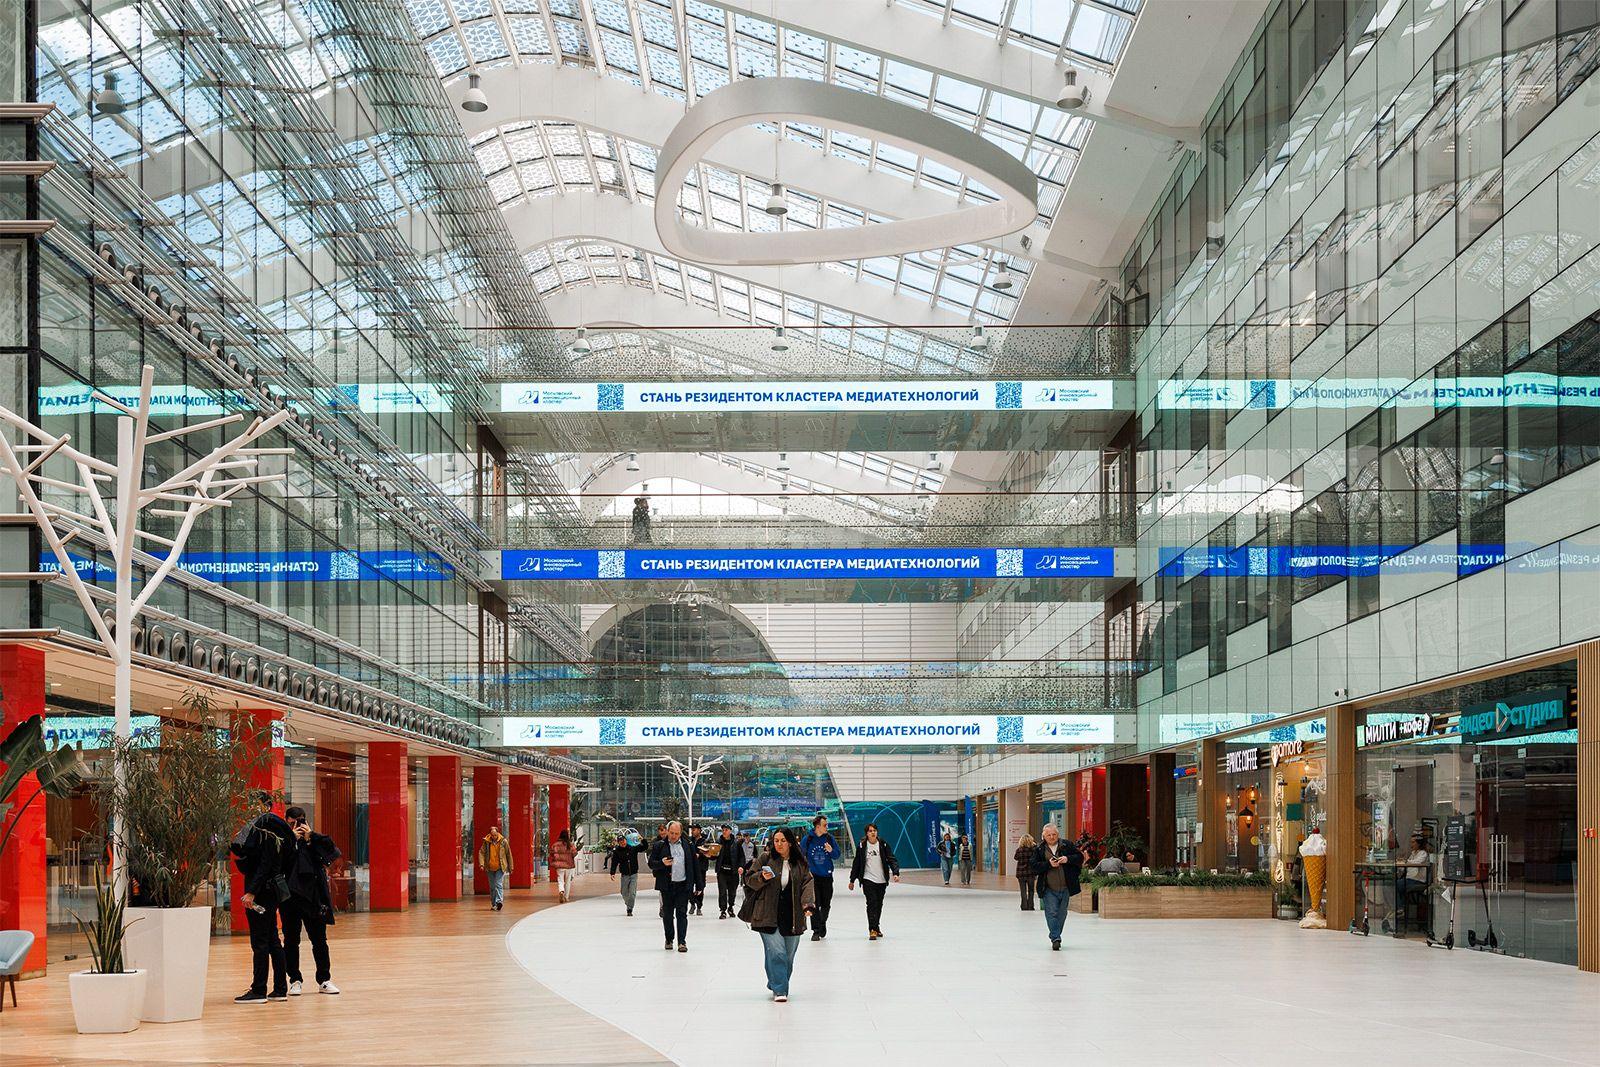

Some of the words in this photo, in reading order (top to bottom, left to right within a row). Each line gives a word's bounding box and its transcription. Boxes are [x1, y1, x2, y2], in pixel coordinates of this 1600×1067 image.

[640, 392, 682, 402] СТАНЬ
[686, 392, 772, 404] РЕЗИДЕНТОМ
[776, 391, 843, 402] КЛАСТЕРА
[847, 388, 978, 403] МЕДИАТЕХНОЛОГИЙ
[641, 559, 683, 570] СТАНЬ
[686, 559, 773, 571] РЕЗИДЕНТОМ
[777, 558, 844, 569] КЛАСТЕРА
[847, 556, 979, 570] МЕДИАТЕХНОЛОГИЙ
[1459, 712, 1493, 736] видео
[1511, 700, 1561, 729] студия
[642, 727, 683, 737] СТАНЬ
[687, 727, 774, 738] РЕЗИДЕНТОМ
[778, 726, 844, 737] КЛАСТЕРА
[848, 723, 980, 737] МЕДИАТЕХНОЛОГИЙ
[1365, 720, 1397, 744] МИЛТИ
[1242, 748, 1258, 771] COFFEE
